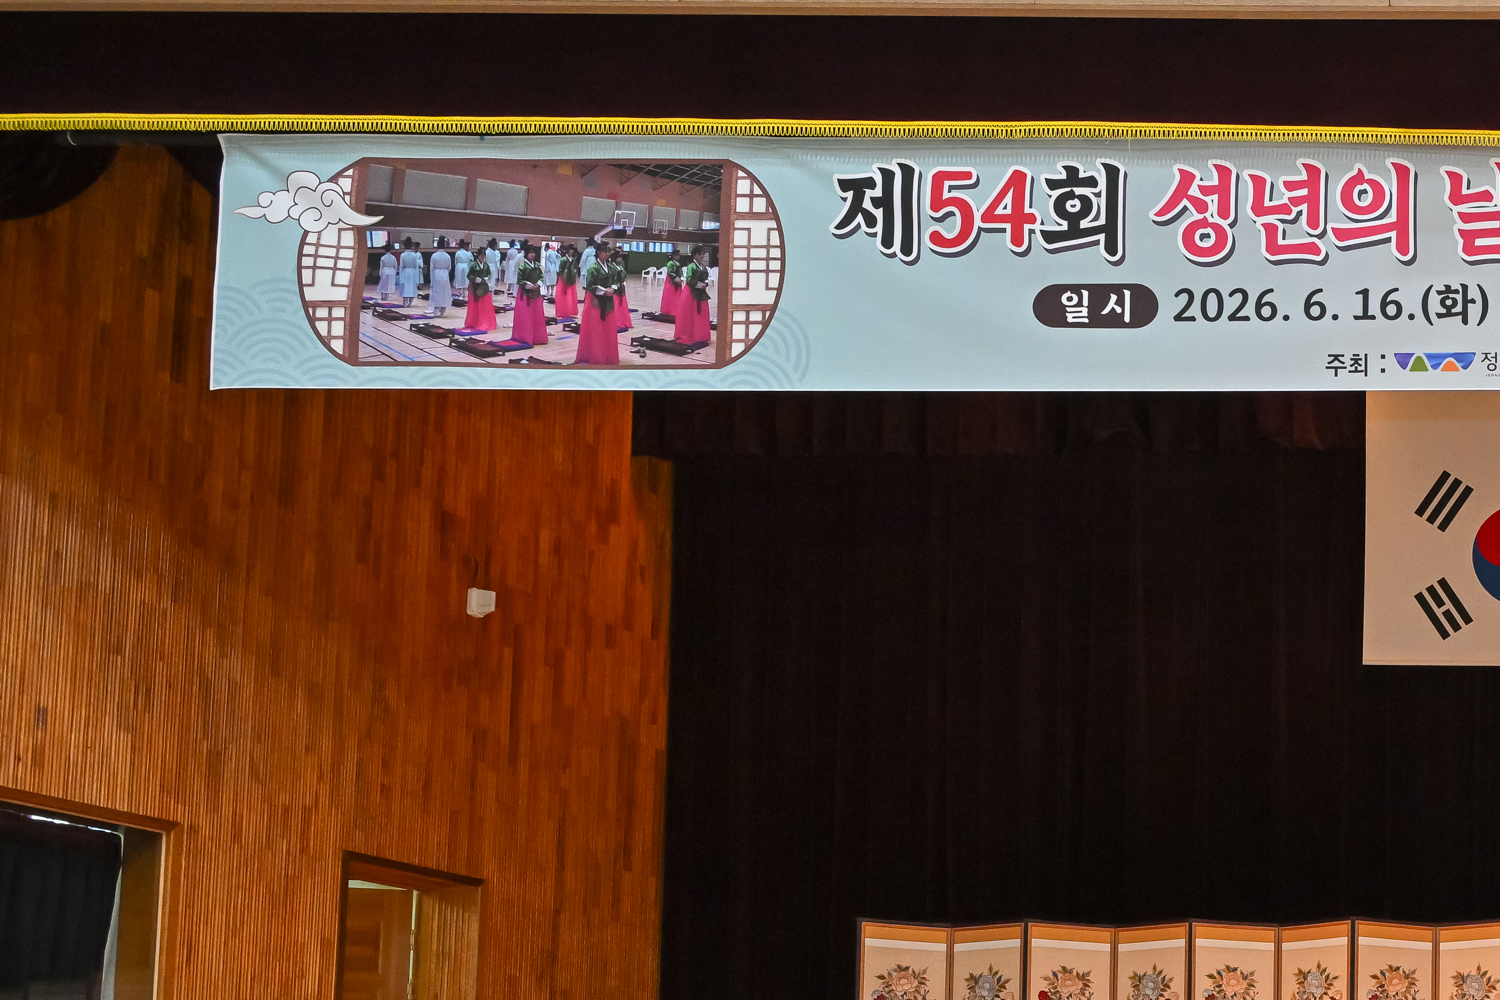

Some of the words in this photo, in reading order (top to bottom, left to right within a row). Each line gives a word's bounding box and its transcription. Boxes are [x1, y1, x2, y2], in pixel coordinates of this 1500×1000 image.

[832, 161, 1126, 260] 제54회
[1151, 160, 1413, 258] 성년의
[1172, 287, 1290, 323] 2026.
[1303, 287, 1340, 323] 6.
[1352, 282, 1490, 327] 16.(화)
[1325, 352, 1369, 377] 주최
